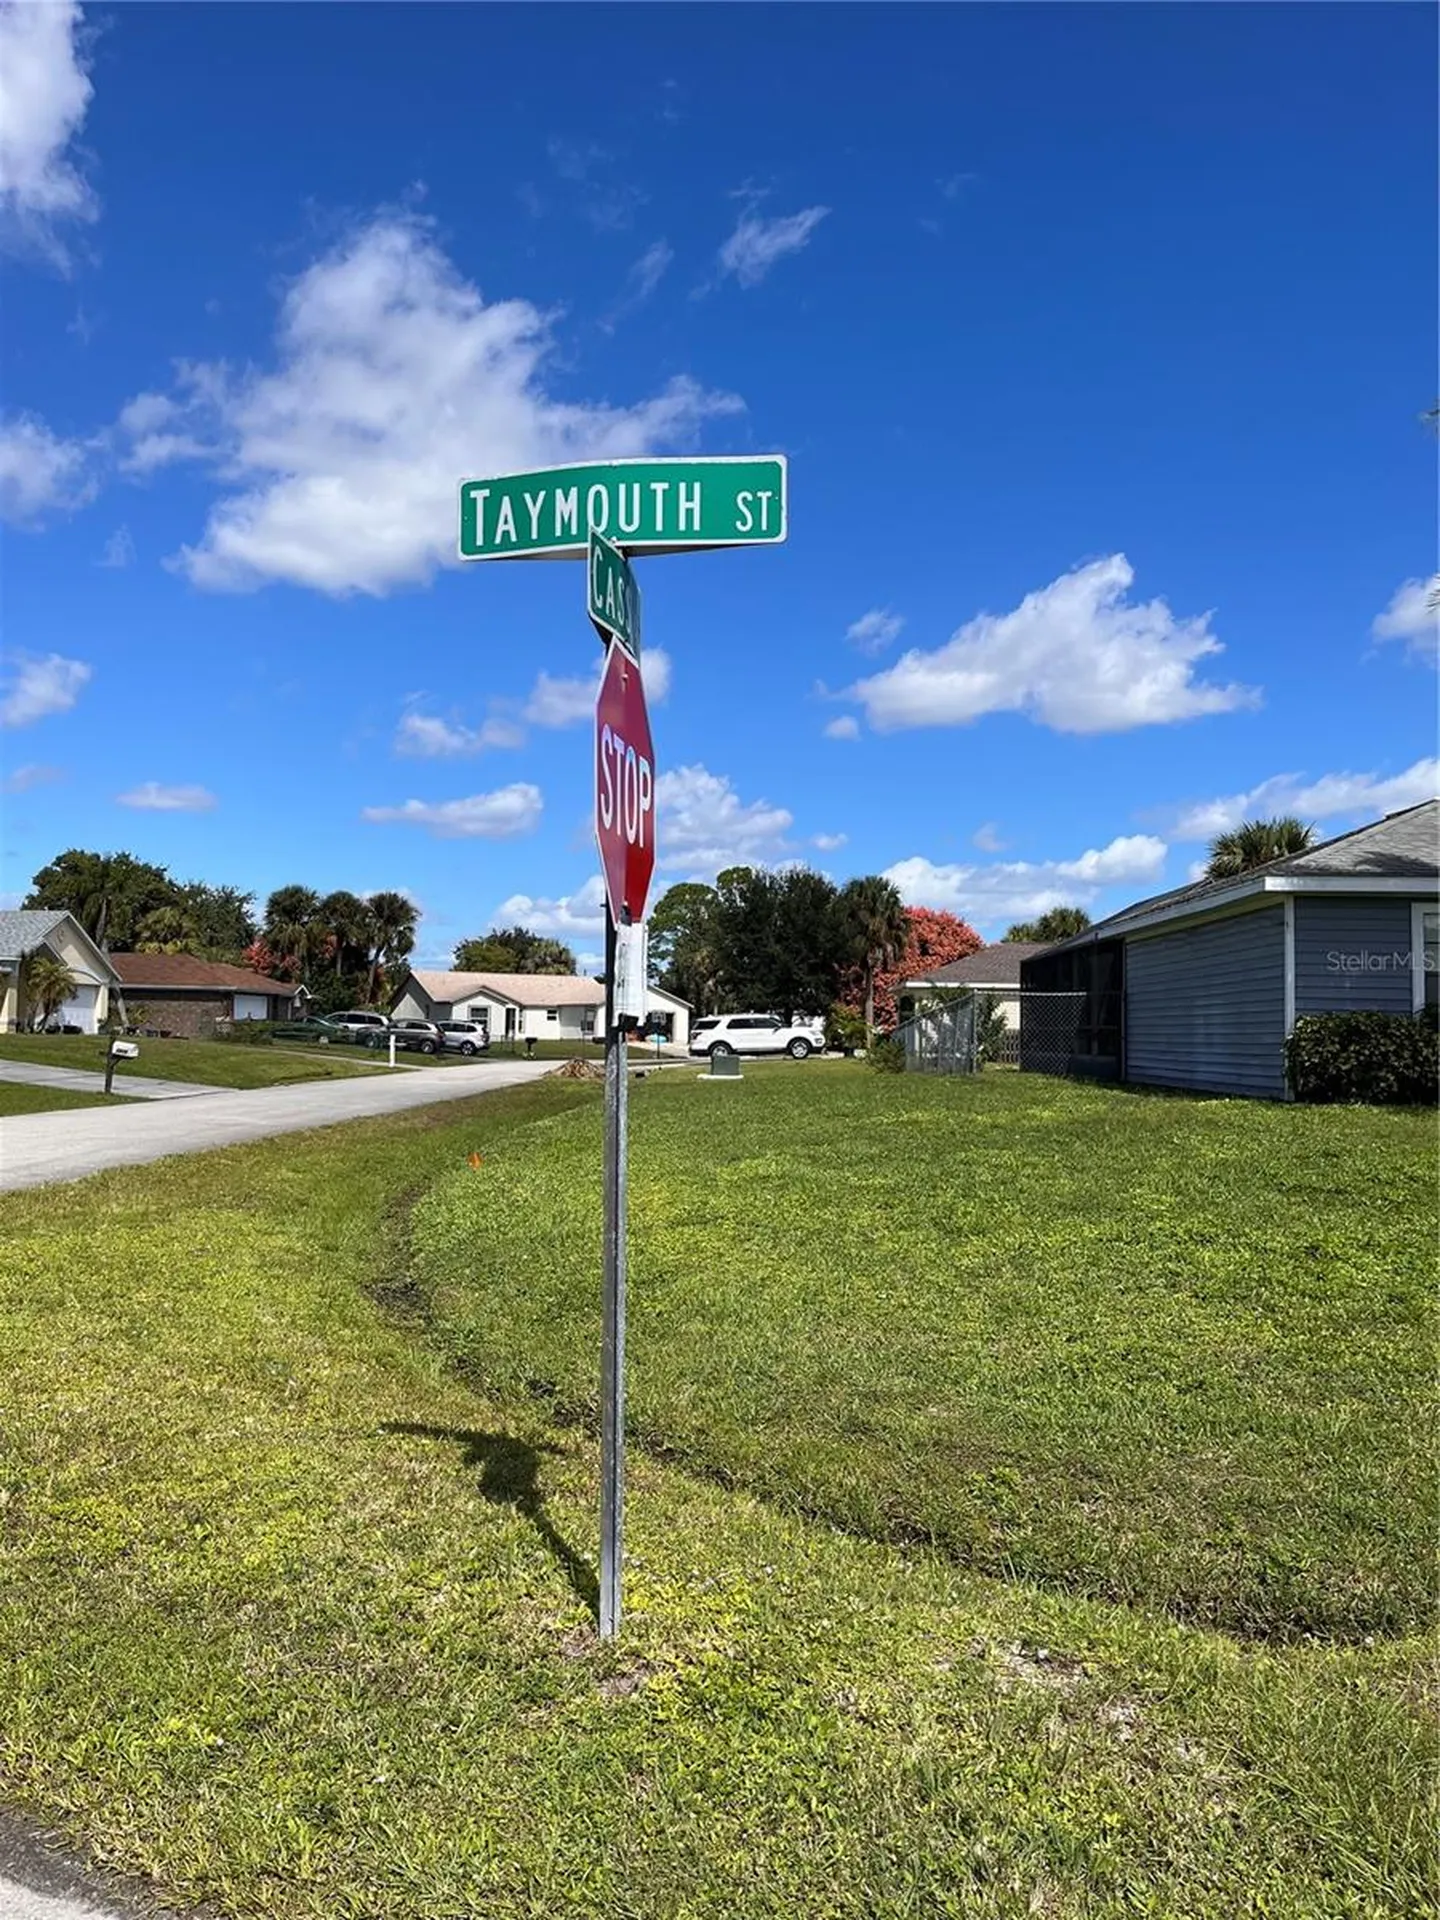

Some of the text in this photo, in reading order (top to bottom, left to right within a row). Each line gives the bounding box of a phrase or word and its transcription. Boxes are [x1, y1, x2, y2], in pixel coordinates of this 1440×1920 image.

[470, 481, 772, 547] TAYMOUTH ST
[600, 722, 652, 848] STOP
